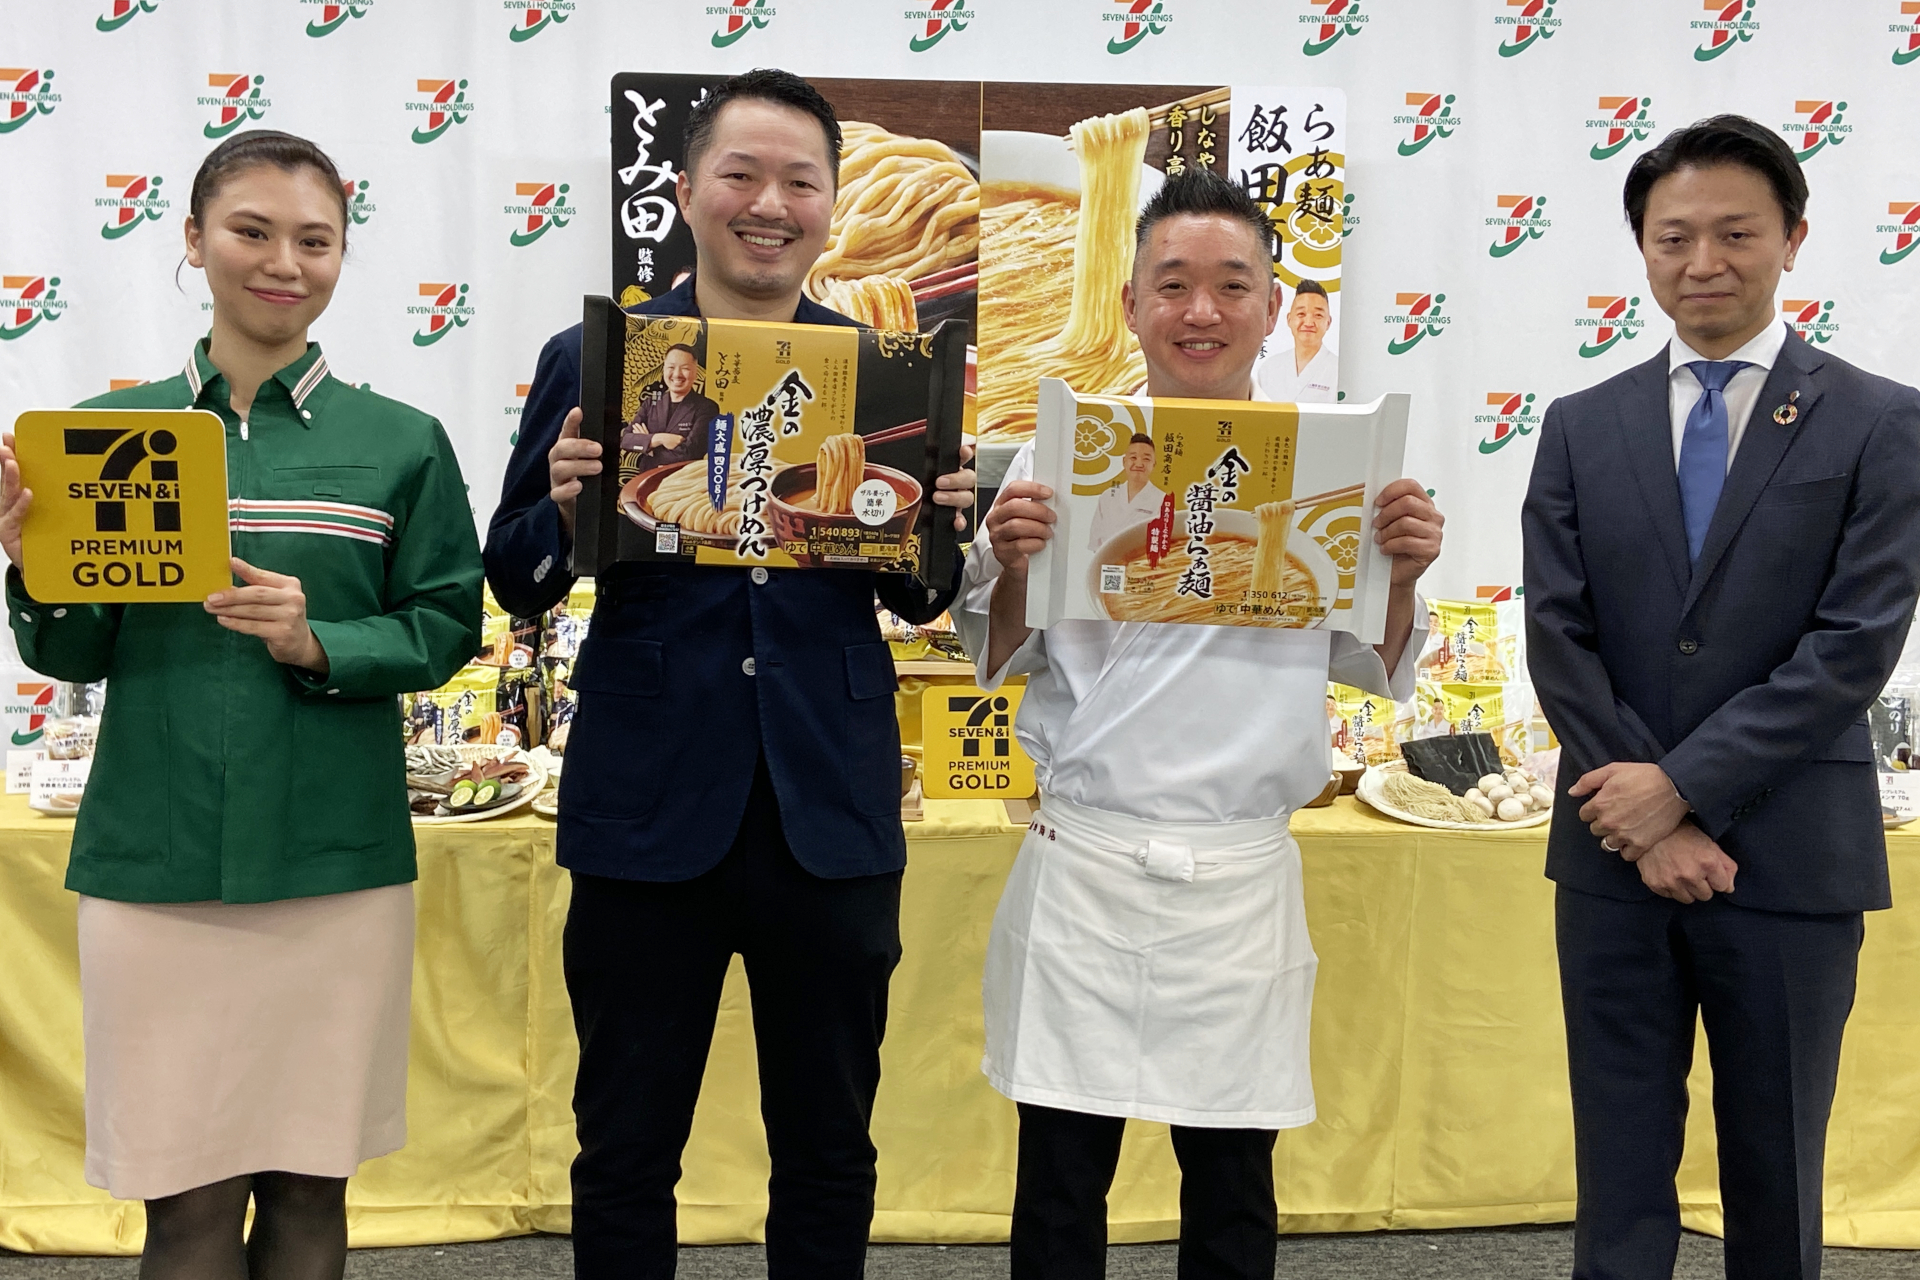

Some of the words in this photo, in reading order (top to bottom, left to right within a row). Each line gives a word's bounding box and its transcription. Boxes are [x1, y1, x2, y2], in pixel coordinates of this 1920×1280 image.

[536, 1, 576, 10] HOLDINGS
[738, 7, 776, 16] HOLDINGS
[937, 10, 975, 19] HOLDINGS
[1135, 14, 1173, 22] HOLDINGS
[1332, 15, 1369, 23] HOLDINGS
[1526, 17, 1562, 27] HOLDINGS
[1722, 21, 1760, 30] HOLDINGS
[22, 93, 62, 102] HOLDINGS
[232, 98, 272, 107] HOLDINGS
[438, 103, 474, 111] HOLDINGS
[1424, 117, 1461, 126] HOLDINGS
[1620, 120, 1656, 129] HOLDINGS
[1814, 124, 1852, 133] HOLDINGS
[1238, 103, 1292, 265] 飯田
[130, 199, 170, 208] HOLDINGS
[538, 207, 576, 215] HOLDINGS
[1517, 218, 1551, 227] HOLDINGS
[637, 248, 655, 282] 監修
[27, 300, 68, 309] HOLDINGS
[439, 307, 475, 316] HOLDINGS
[1414, 316, 1451, 324] HOLDINGS
[1608, 319, 1645, 328] HOLDINGS
[1803, 322, 1839, 331] HOLDINGS
[767, 371, 813, 435] 金の
[1505, 416, 1540, 424] HOLDINGS
[1208, 448, 1249, 502] 金の
[738, 404, 775, 558] 濃厚つけめん
[866, 498, 883, 507] 簡単
[861, 508, 886, 518] 水切り
[820, 527, 839, 537] 540
[841, 528, 860, 538] 893
[70, 539, 183, 555] PREMIUM
[810, 541, 858, 557] 中華めん
[72, 561, 185, 587] GOLD
[1251, 590, 1268, 599] 350
[1271, 591, 1288, 599] 612
[1240, 603, 1285, 616] 中華めん
[949, 760, 1010, 771] PREMIUM
[949, 774, 1011, 790] GOLD
